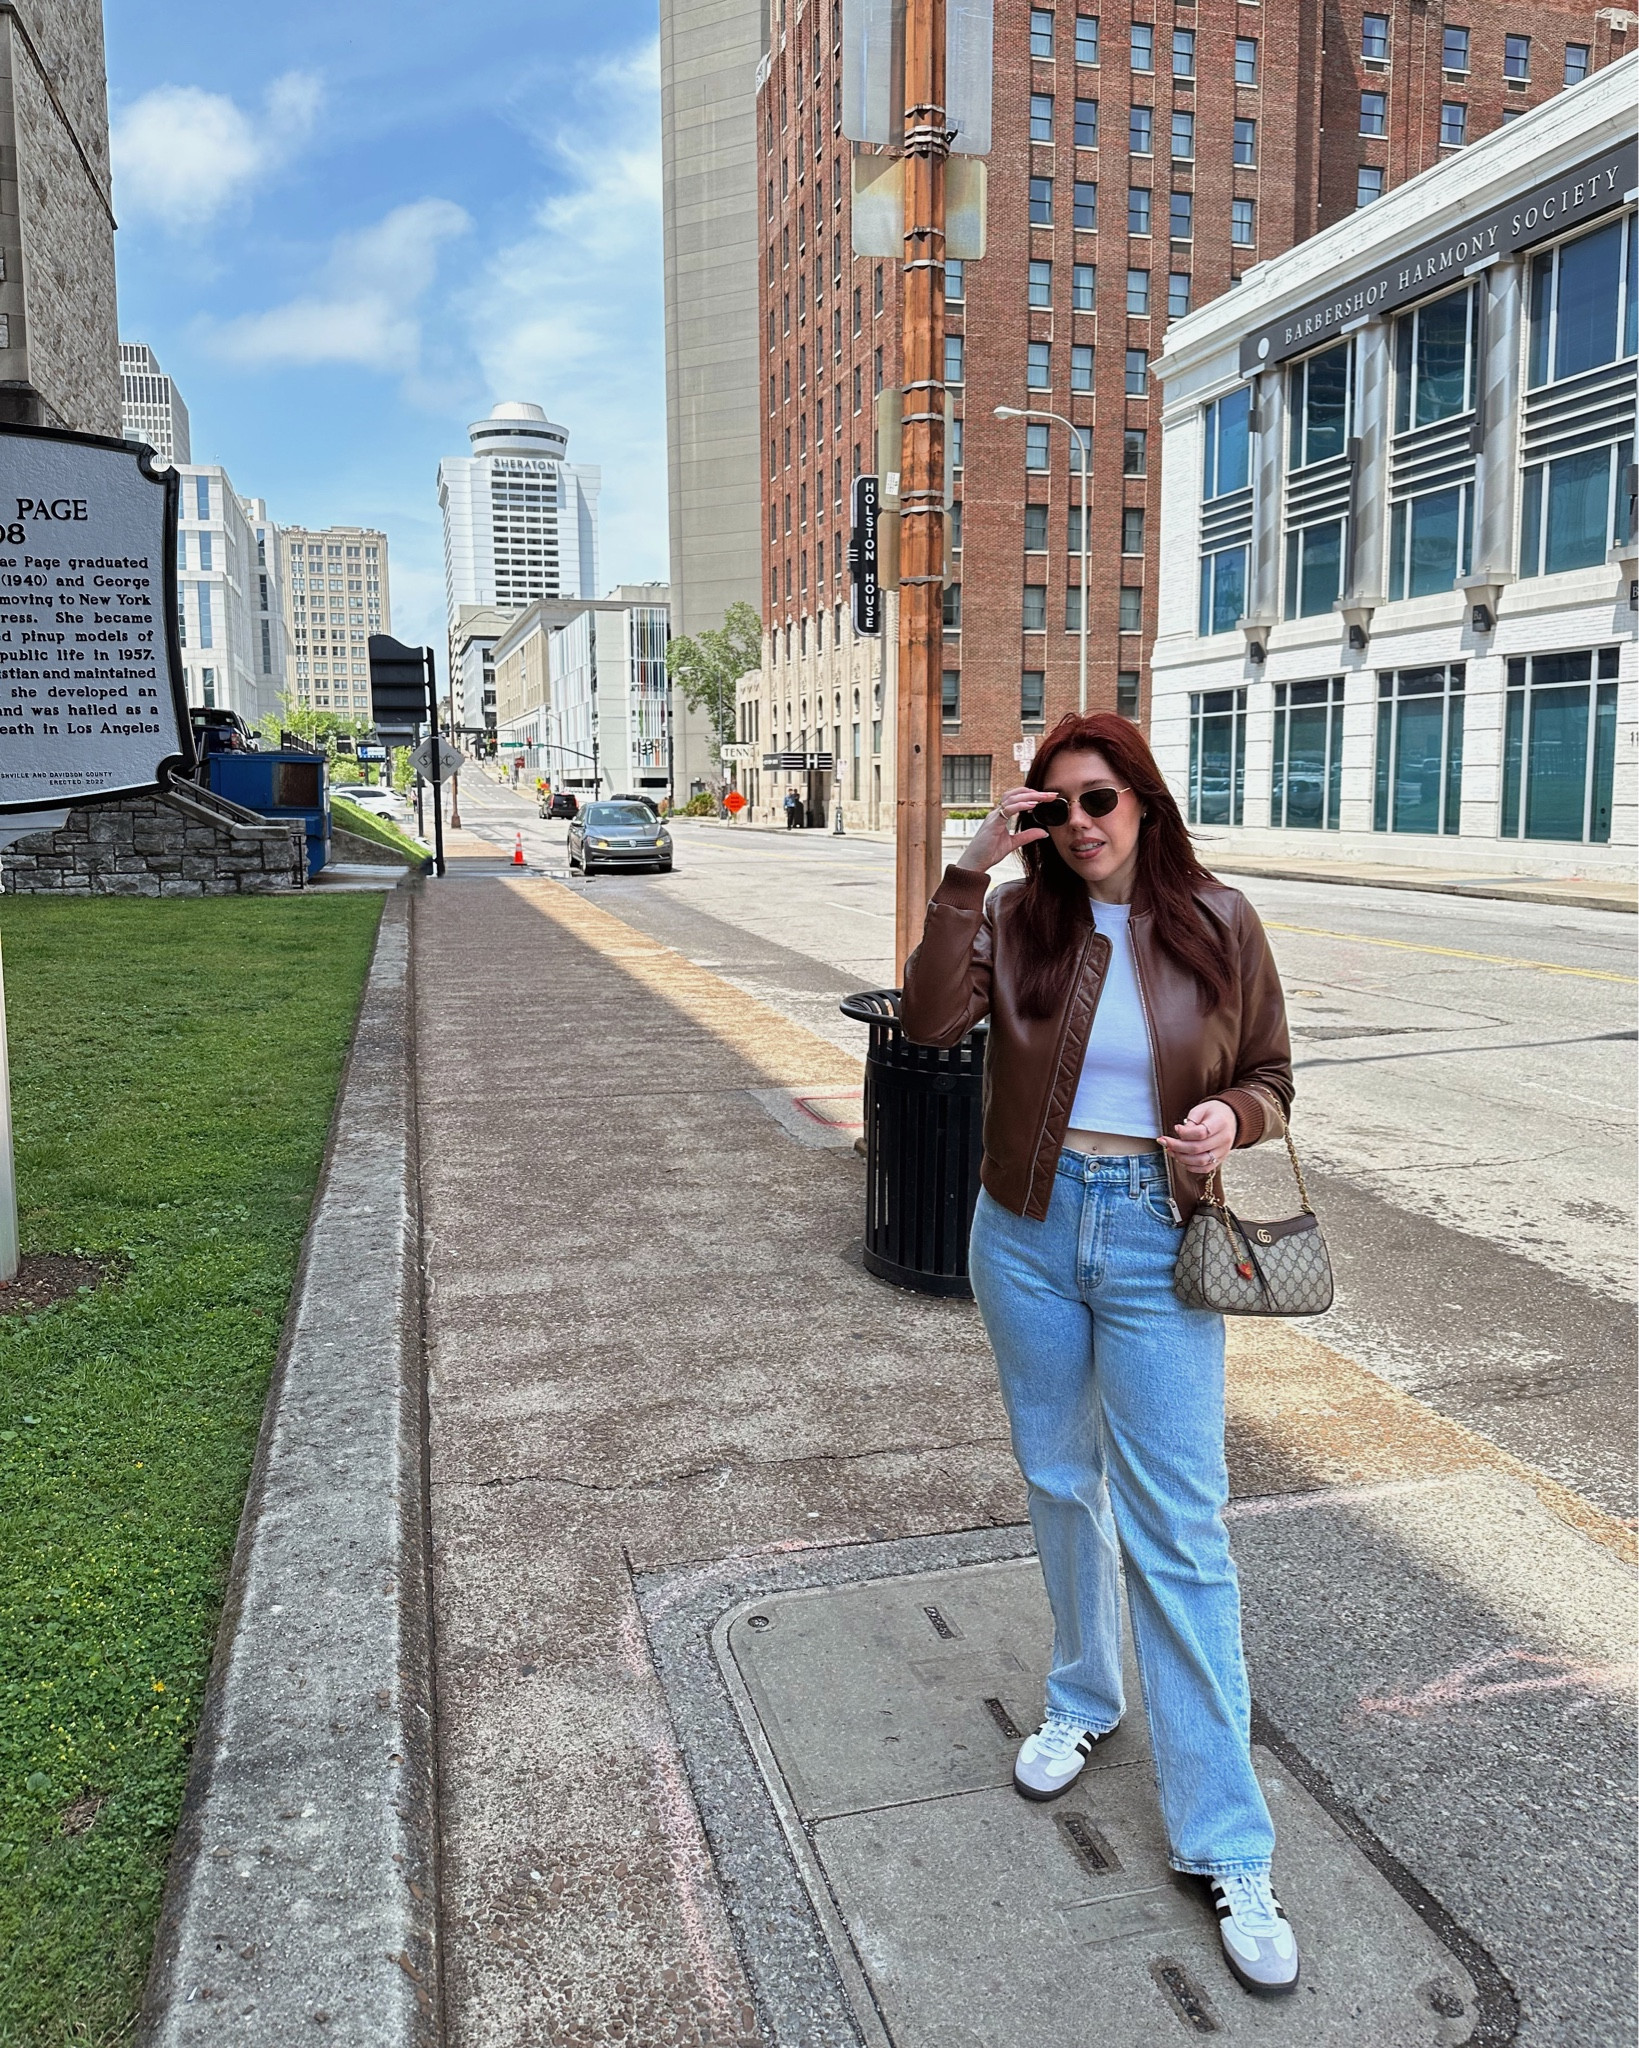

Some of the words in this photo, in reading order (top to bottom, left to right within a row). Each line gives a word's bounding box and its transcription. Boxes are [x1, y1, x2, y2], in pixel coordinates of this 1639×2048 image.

[1284, 280, 1388, 346] BARBERSHOP
[1398, 225, 1499, 291] HARMONY
[1511, 165, 1620, 237] SOCIETY
[494, 458, 555, 470] SHERATON
[16, 498, 88, 521] PAGE
[865, 482, 875, 561] HOLSTON
[24, 556, 60, 570] Page
[69, 557, 149, 571] graduated
[1, 574, 47, 587] (1940)
[56, 576, 84, 587] and
[93, 576, 150, 589] George
[0, 593, 53, 607] moving
[59, 594, 75, 605] to
[79, 594, 111, 605] New
[117, 594, 152, 606] York
[865, 573, 875, 628] HOUSE
[56, 612, 84, 624] She
[94, 612, 152, 624] became
[21, 630, 65, 644] pinup
[75, 630, 128, 642] models
[138, 630, 153, 642] of
[0, 649, 48, 663] public
[57, 649, 85, 661] life
[94, 649, 109, 661] in
[118, 649, 155, 661] 1957.
[42, 668, 70, 679] and
[74, 667, 156, 679] maintained
[11, 686, 37, 698] she
[48, 686, 128, 701] developed
[138, 687, 157, 697] an
[31, 706, 59, 716] was
[68, 704, 117, 716] hailed
[126, 706, 141, 715] as
[150, 706, 159, 715] a
[43, 723, 59, 735] in
[67, 722, 92, 734] Los
[100, 722, 160, 736] Angeles
[806, 754, 818, 769] H
